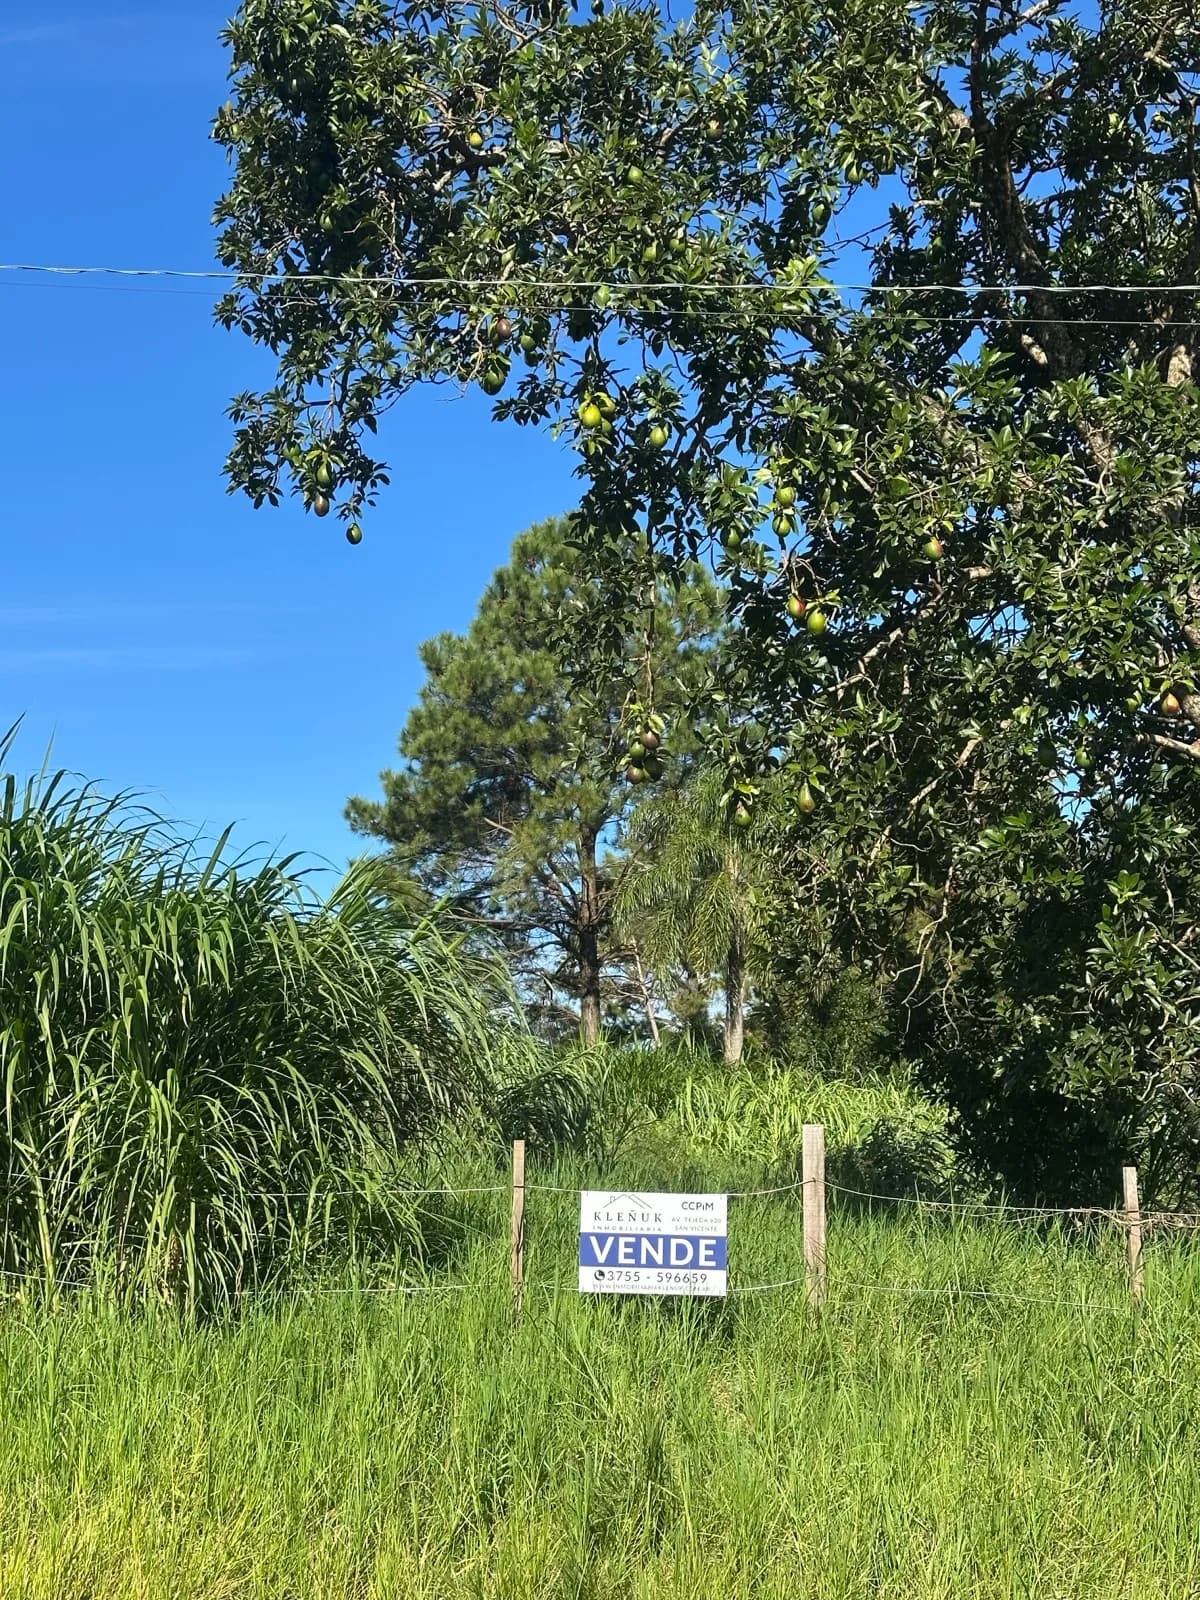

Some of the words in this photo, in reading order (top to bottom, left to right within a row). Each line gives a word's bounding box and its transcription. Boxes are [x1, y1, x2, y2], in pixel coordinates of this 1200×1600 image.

[593, 1209, 662, 1223] KLEÑUK
[589, 1236, 717, 1267] VENDE
[607, 1270, 641, 1282] 3755
[657, 1272, 708, 1284] 596659
